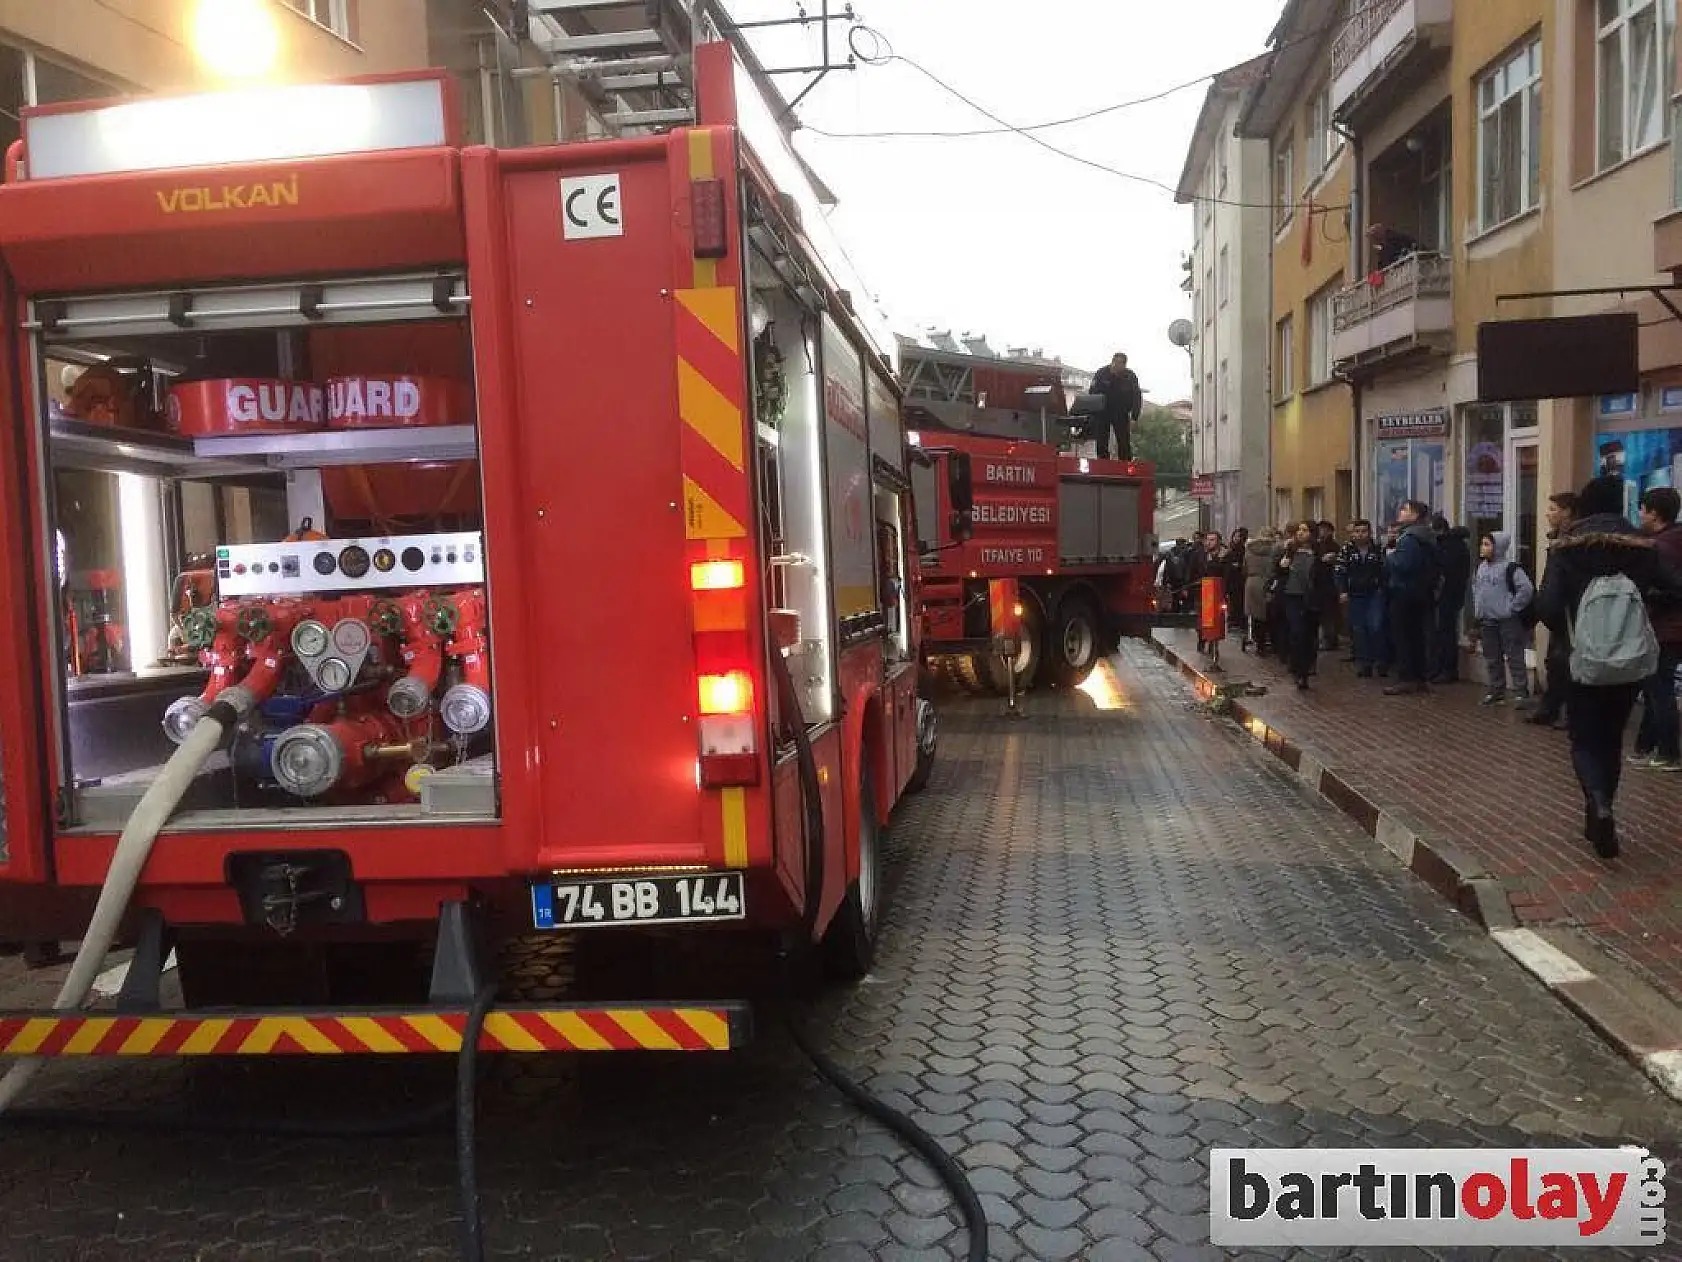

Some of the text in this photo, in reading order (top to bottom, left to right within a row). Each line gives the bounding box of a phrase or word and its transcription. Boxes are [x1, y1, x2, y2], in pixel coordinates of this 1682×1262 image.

[157, 176, 299, 214] VOLKAN
[565, 183, 620, 228] CE
[227, 384, 324, 422] GUAR
[328, 379, 420, 419] UARD
[557, 877, 740, 923] 74 BB 144
